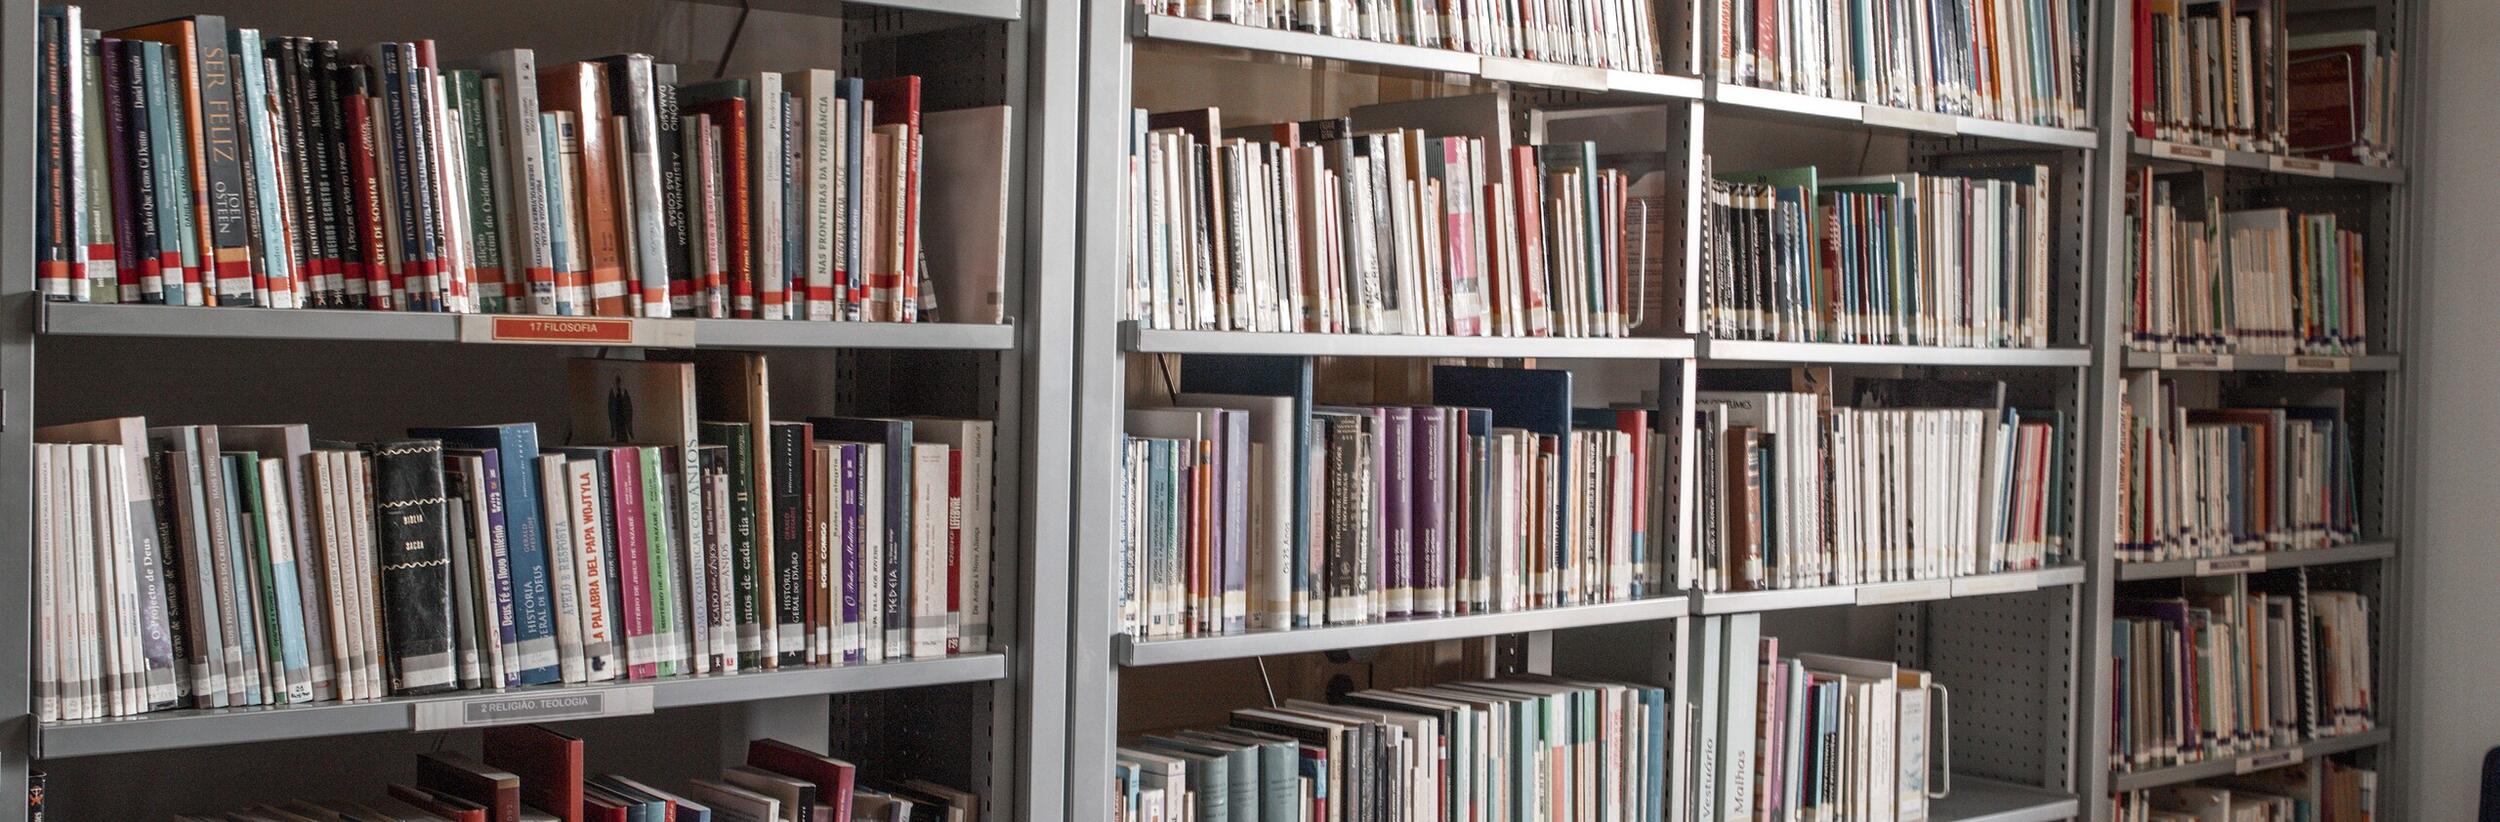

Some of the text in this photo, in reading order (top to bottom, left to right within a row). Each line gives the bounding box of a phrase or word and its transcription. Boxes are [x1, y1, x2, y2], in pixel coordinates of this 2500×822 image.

[133, 86, 144, 108] Daniel
[203, 47, 234, 162] SER FELIZ
[310, 101, 321, 128] Michael
[658, 84, 671, 131] DAMÁSIO
[667, 84, 679, 132] ANTÓNIO
[138, 131, 155, 236] Tudo Que Temos Cá Dentro
[305, 196, 313, 212] DAS
[341, 187, 352, 204] Vida
[479, 167, 494, 228] do Ocidente
[665, 171, 678, 227] DAS COISAS
[671, 152, 687, 246] A ESTRANHA ORDEM
[816, 96, 828, 275] NAS FRONTEIRAS DA TOLERÂNCIA
[215, 181, 230, 234] OSTEEN
[228, 193, 242, 224] JOEL
[344, 204, 353, 215] de
[368, 177, 386, 266] ARTE DE SONHAR
[307, 215, 319, 255] HISTÓRIA
[531, 322, 598, 333] 17 FILOSOFIA
[581, 472, 594, 524] WOJTYLA
[950, 497, 960, 530] LEFEBVRE
[207, 455, 233, 623] PENSADORES DO CRISTIANISMO HANS KÜNG
[330, 550, 338, 569] DOS
[522, 523, 531, 553] GERALD
[554, 520, 570, 571] RESPOSTA
[585, 527, 596, 554] PAPA
[628, 515, 641, 596] DE JESUS DE NAZARÉ
[685, 438, 707, 642] COMO COMUNICAR COM ANJOS
[737, 491, 751, 590] de cada II
[973, 527, 981, 552] Aliança
[1360, 530, 1368, 574] minutos
[142, 538, 163, 640] O Projecto de Deus
[332, 570, 341, 601] PODER
[493, 524, 513, 626] Deus, Fé Novo Milénio
[532, 564, 544, 592] DEUS
[586, 556, 598, 577] DEL
[707, 543, 721, 627] OCADO ANJOS
[720, 543, 732, 623] CURA ANJOS
[791, 551, 800, 623] GERAL DO DIABO
[523, 581, 537, 633] HISTÓRIA
[537, 595, 545, 606] DE
[559, 584, 574, 616] APELO
[588, 580, 603, 629] PALABRA
[783, 568, 792, 611] HISTÓRIA
[845, 596, 856, 607] O
[888, 569, 898, 613] MEDEIA
[973, 581, 981, 603] Antiga
[973, 605, 979, 615] Da
[481, 697, 589, 712] 2 RELIGIÃO. TEOLOGIA
[1703, 737, 1713, 818] Vestuário
[1734, 750, 1745, 814] Malhas
